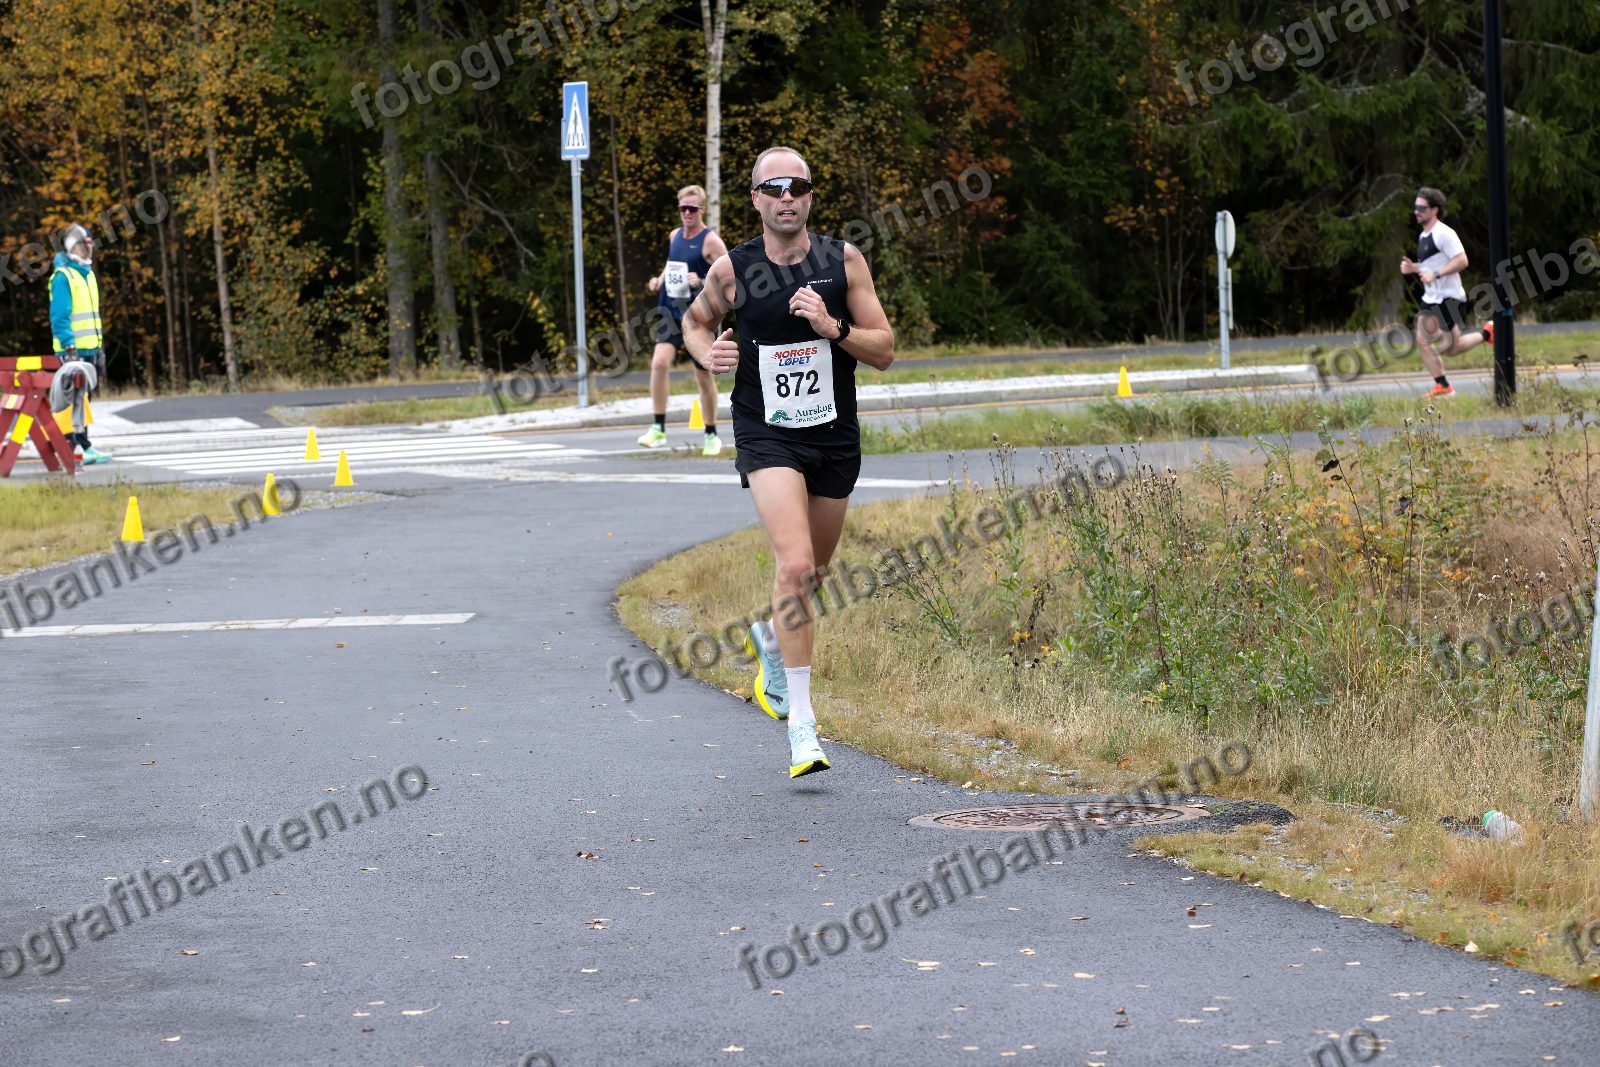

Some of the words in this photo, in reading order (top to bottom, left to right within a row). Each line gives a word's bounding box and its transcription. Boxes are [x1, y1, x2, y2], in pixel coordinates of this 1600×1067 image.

[773, 347, 818, 360] NORGES
[779, 356, 812, 367] LØPET
[776, 370, 821, 398] 872
[795, 403, 833, 418] Aurskog
